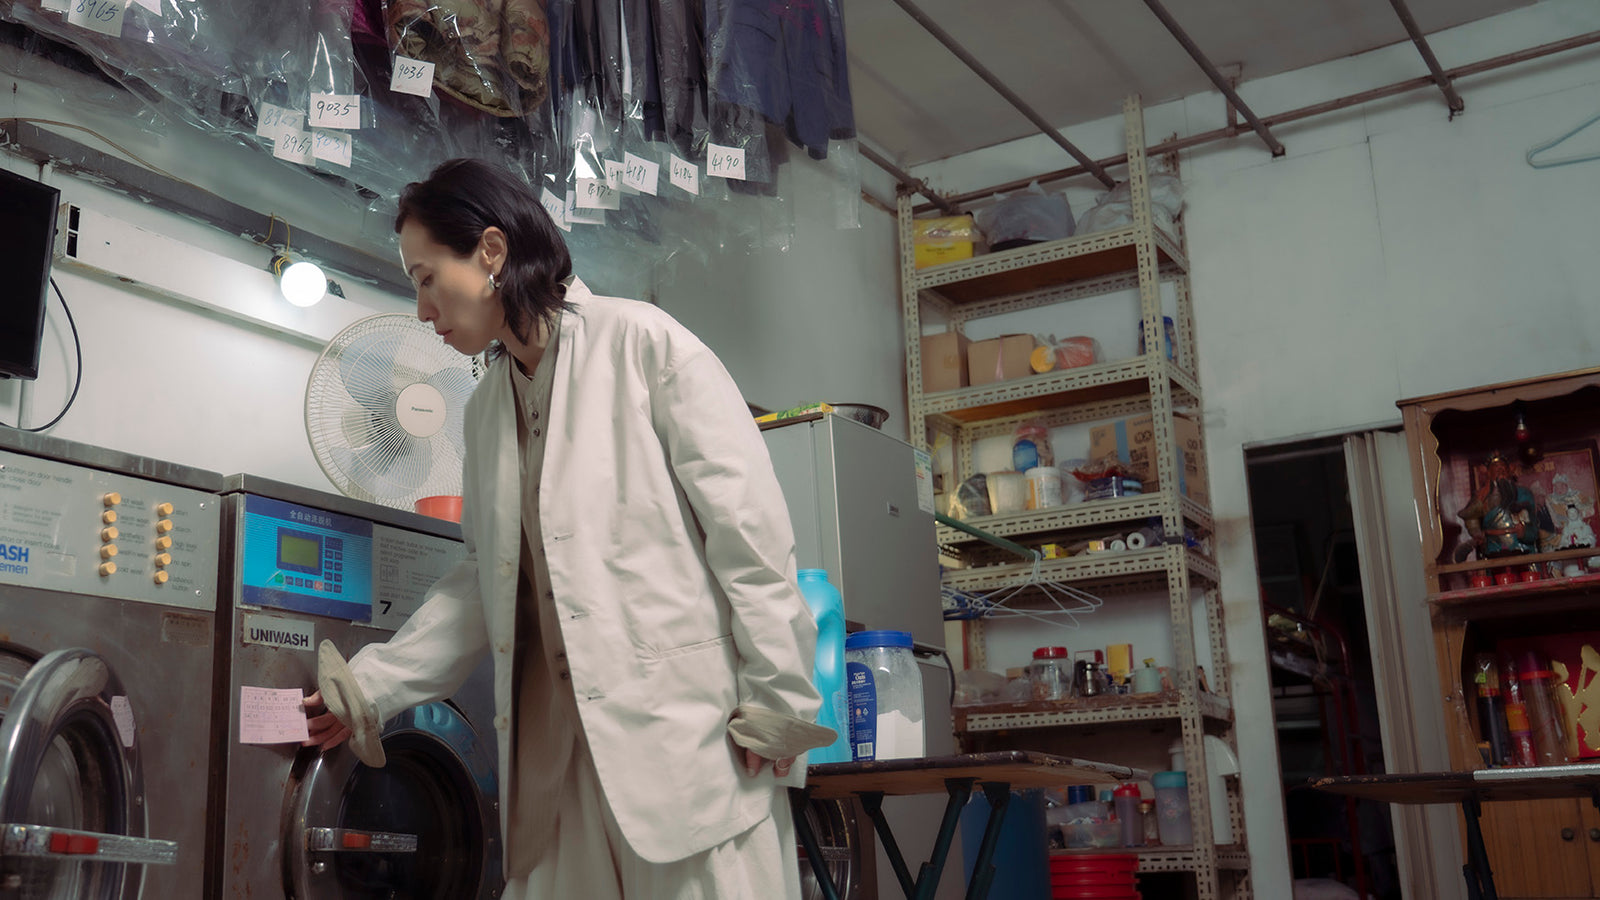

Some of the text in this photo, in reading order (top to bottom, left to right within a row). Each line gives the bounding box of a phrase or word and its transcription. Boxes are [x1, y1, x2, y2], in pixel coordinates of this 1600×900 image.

[398, 64, 425, 79] 9036
[316, 101, 358, 119] 9035
[282, 134, 313, 155] 8967
[316, 130, 348, 154] 9031
[711, 153, 739, 171] 4190
[626, 160, 647, 185] 4181
[673, 162, 692, 183] 4184
[380, 600, 392, 614] 7
[250, 627, 309, 647] UNIWASH
